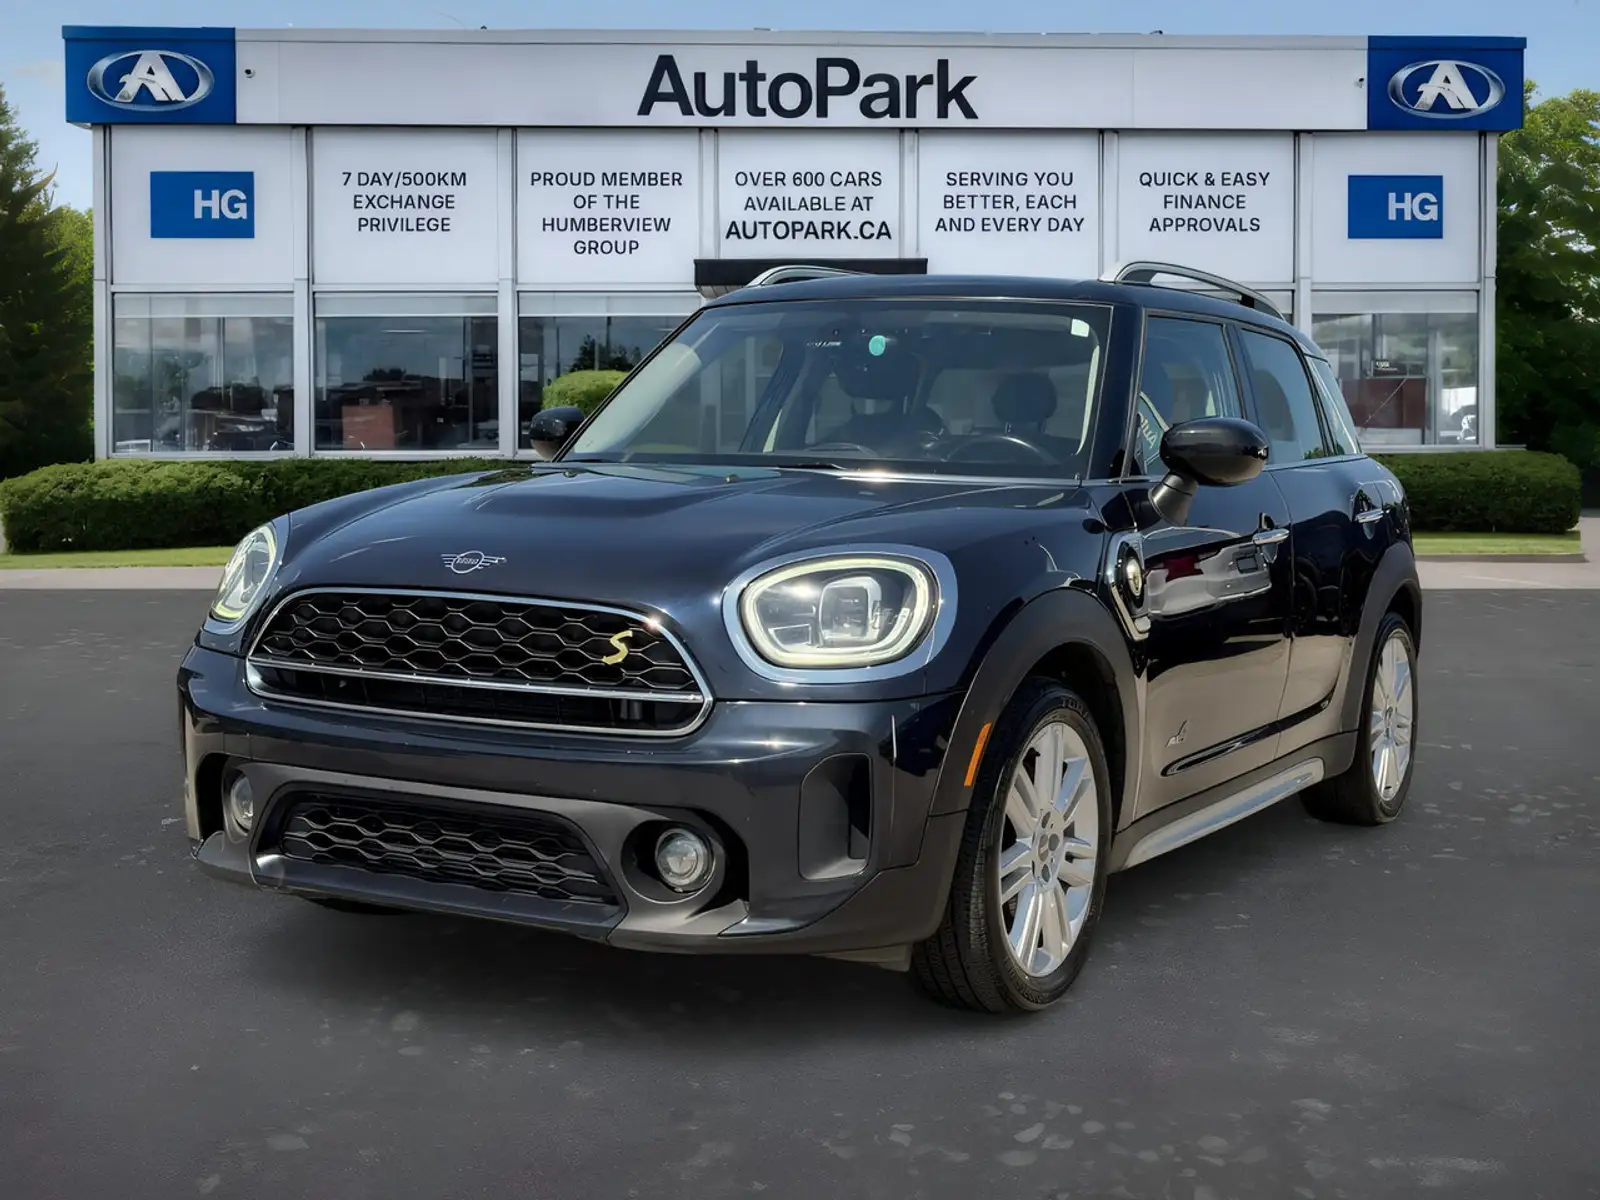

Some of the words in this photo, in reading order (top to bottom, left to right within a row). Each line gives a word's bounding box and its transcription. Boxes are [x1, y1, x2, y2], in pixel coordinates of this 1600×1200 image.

[637, 54, 979, 119] AutoPark
[342, 171, 352, 186] 7
[357, 171, 467, 189] DAY/500KM
[530, 171, 596, 187] PROUD
[601, 171, 683, 187] MEMBER
[734, 171, 787, 187] OVER
[792, 171, 825, 187] 600
[830, 171, 882, 187] CARS
[946, 171, 1028, 187] SERVING
[1033, 171, 1074, 187] YOU
[1139, 171, 1199, 188] QUICK
[1204, 172, 1216, 187] &
[1221, 171, 1271, 187] EASY
[194, 189, 248, 219] HG
[353, 194, 455, 210] EXCHANGE
[573, 194, 598, 210] OF
[603, 194, 640, 210] THE
[743, 196, 846, 212] AVAILABLE
[850, 196, 874, 212] AT
[943, 194, 1020, 212] BETTER,
[1026, 194, 1077, 210] EACH
[1163, 194, 1246, 210] FINANCE
[1388, 192, 1438, 221] HG
[358, 217, 451, 232] PRIVILEGE
[542, 217, 671, 232] HUMBERVIEW
[725, 220, 892, 240] AUTOPARK.CA
[934, 217, 976, 232] AND
[981, 217, 1042, 232] EVERY
[1047, 217, 1085, 232] DAY
[1149, 217, 1261, 232] APPROVALS
[573, 239, 640, 255] GROUP
[602, 630, 633, 665] S
